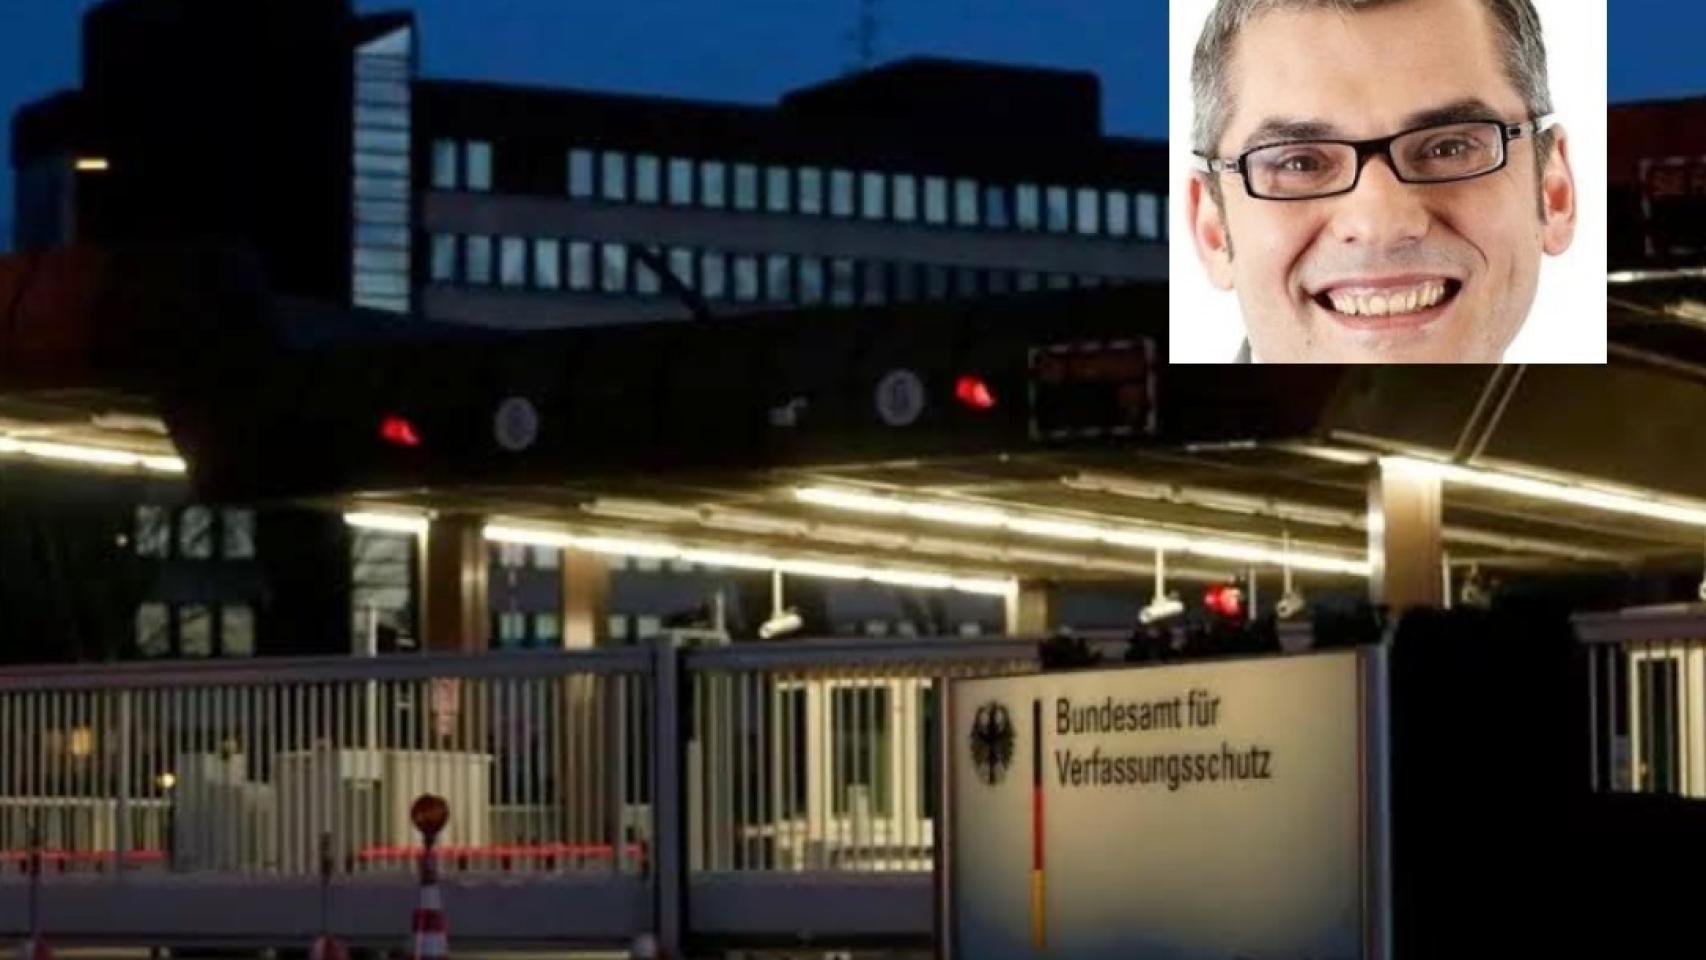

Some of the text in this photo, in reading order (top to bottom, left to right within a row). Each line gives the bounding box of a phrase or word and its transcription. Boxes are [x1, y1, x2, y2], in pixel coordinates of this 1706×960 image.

[1056, 690, 1220, 735] Bundesamt für
[1055, 741, 1272, 791] Verfassungsschutz
